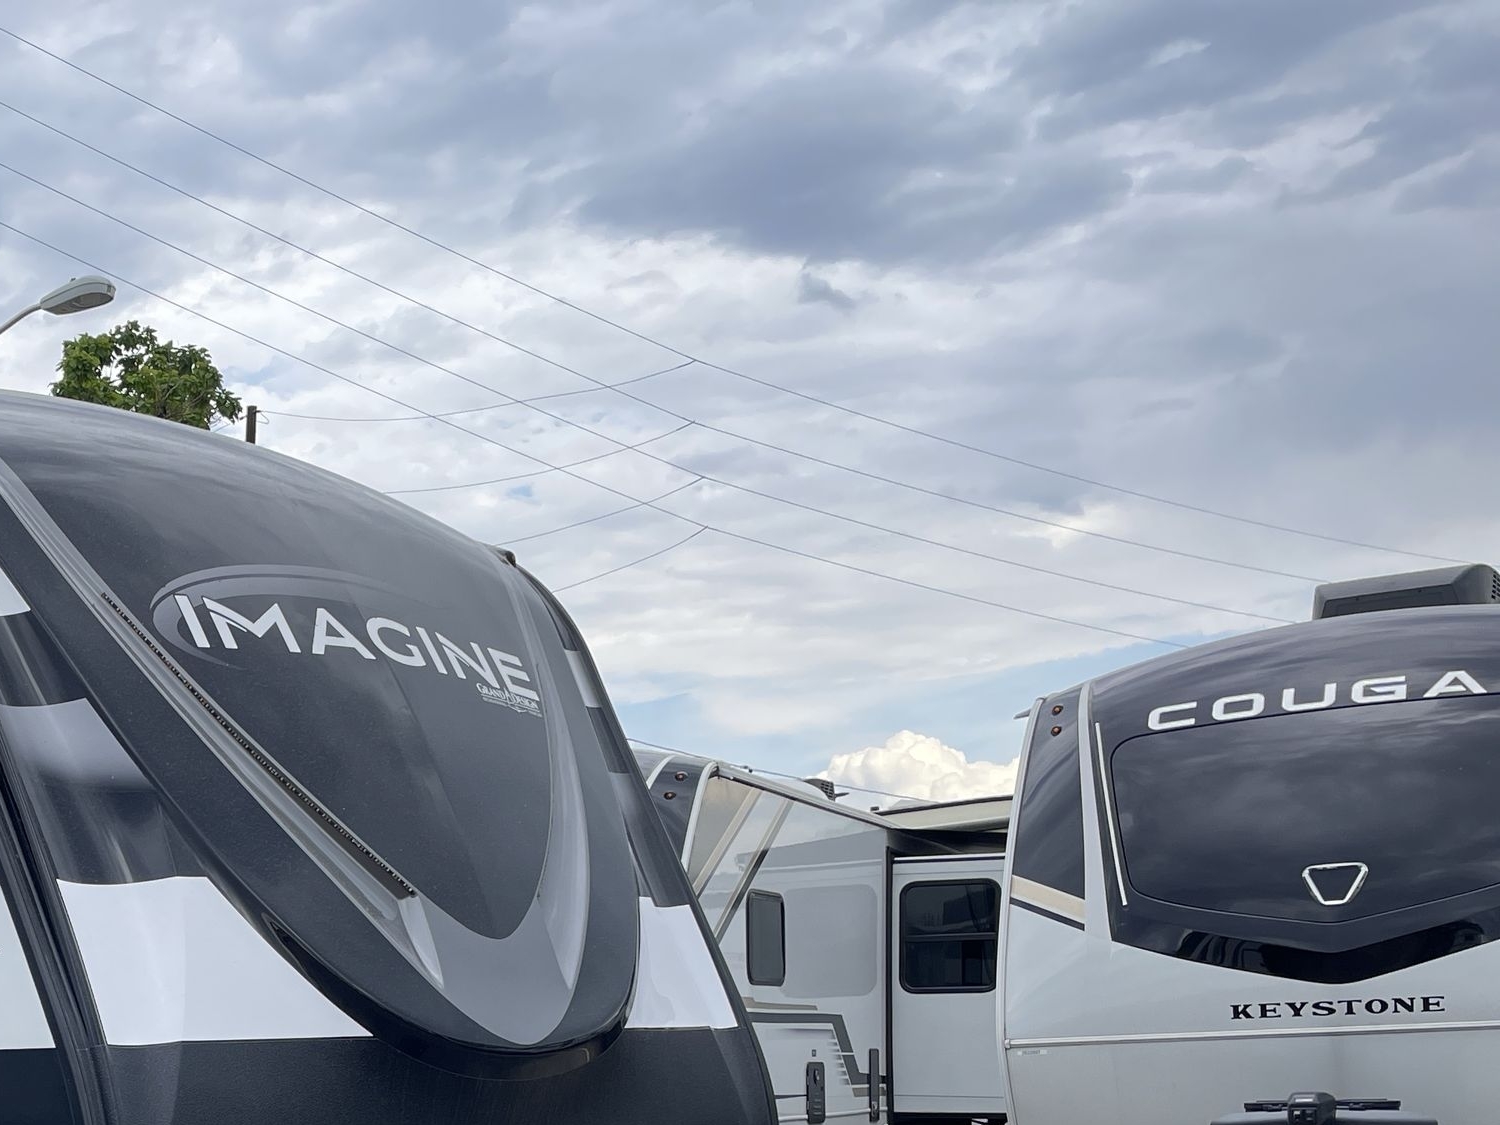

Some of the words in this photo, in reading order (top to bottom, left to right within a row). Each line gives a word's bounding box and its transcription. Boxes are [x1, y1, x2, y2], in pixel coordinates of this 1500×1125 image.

[173, 593, 541, 702] IMAGINE
[1147, 670, 1488, 731] COUGA
[1230, 996, 1446, 1020] KEYSTONE
